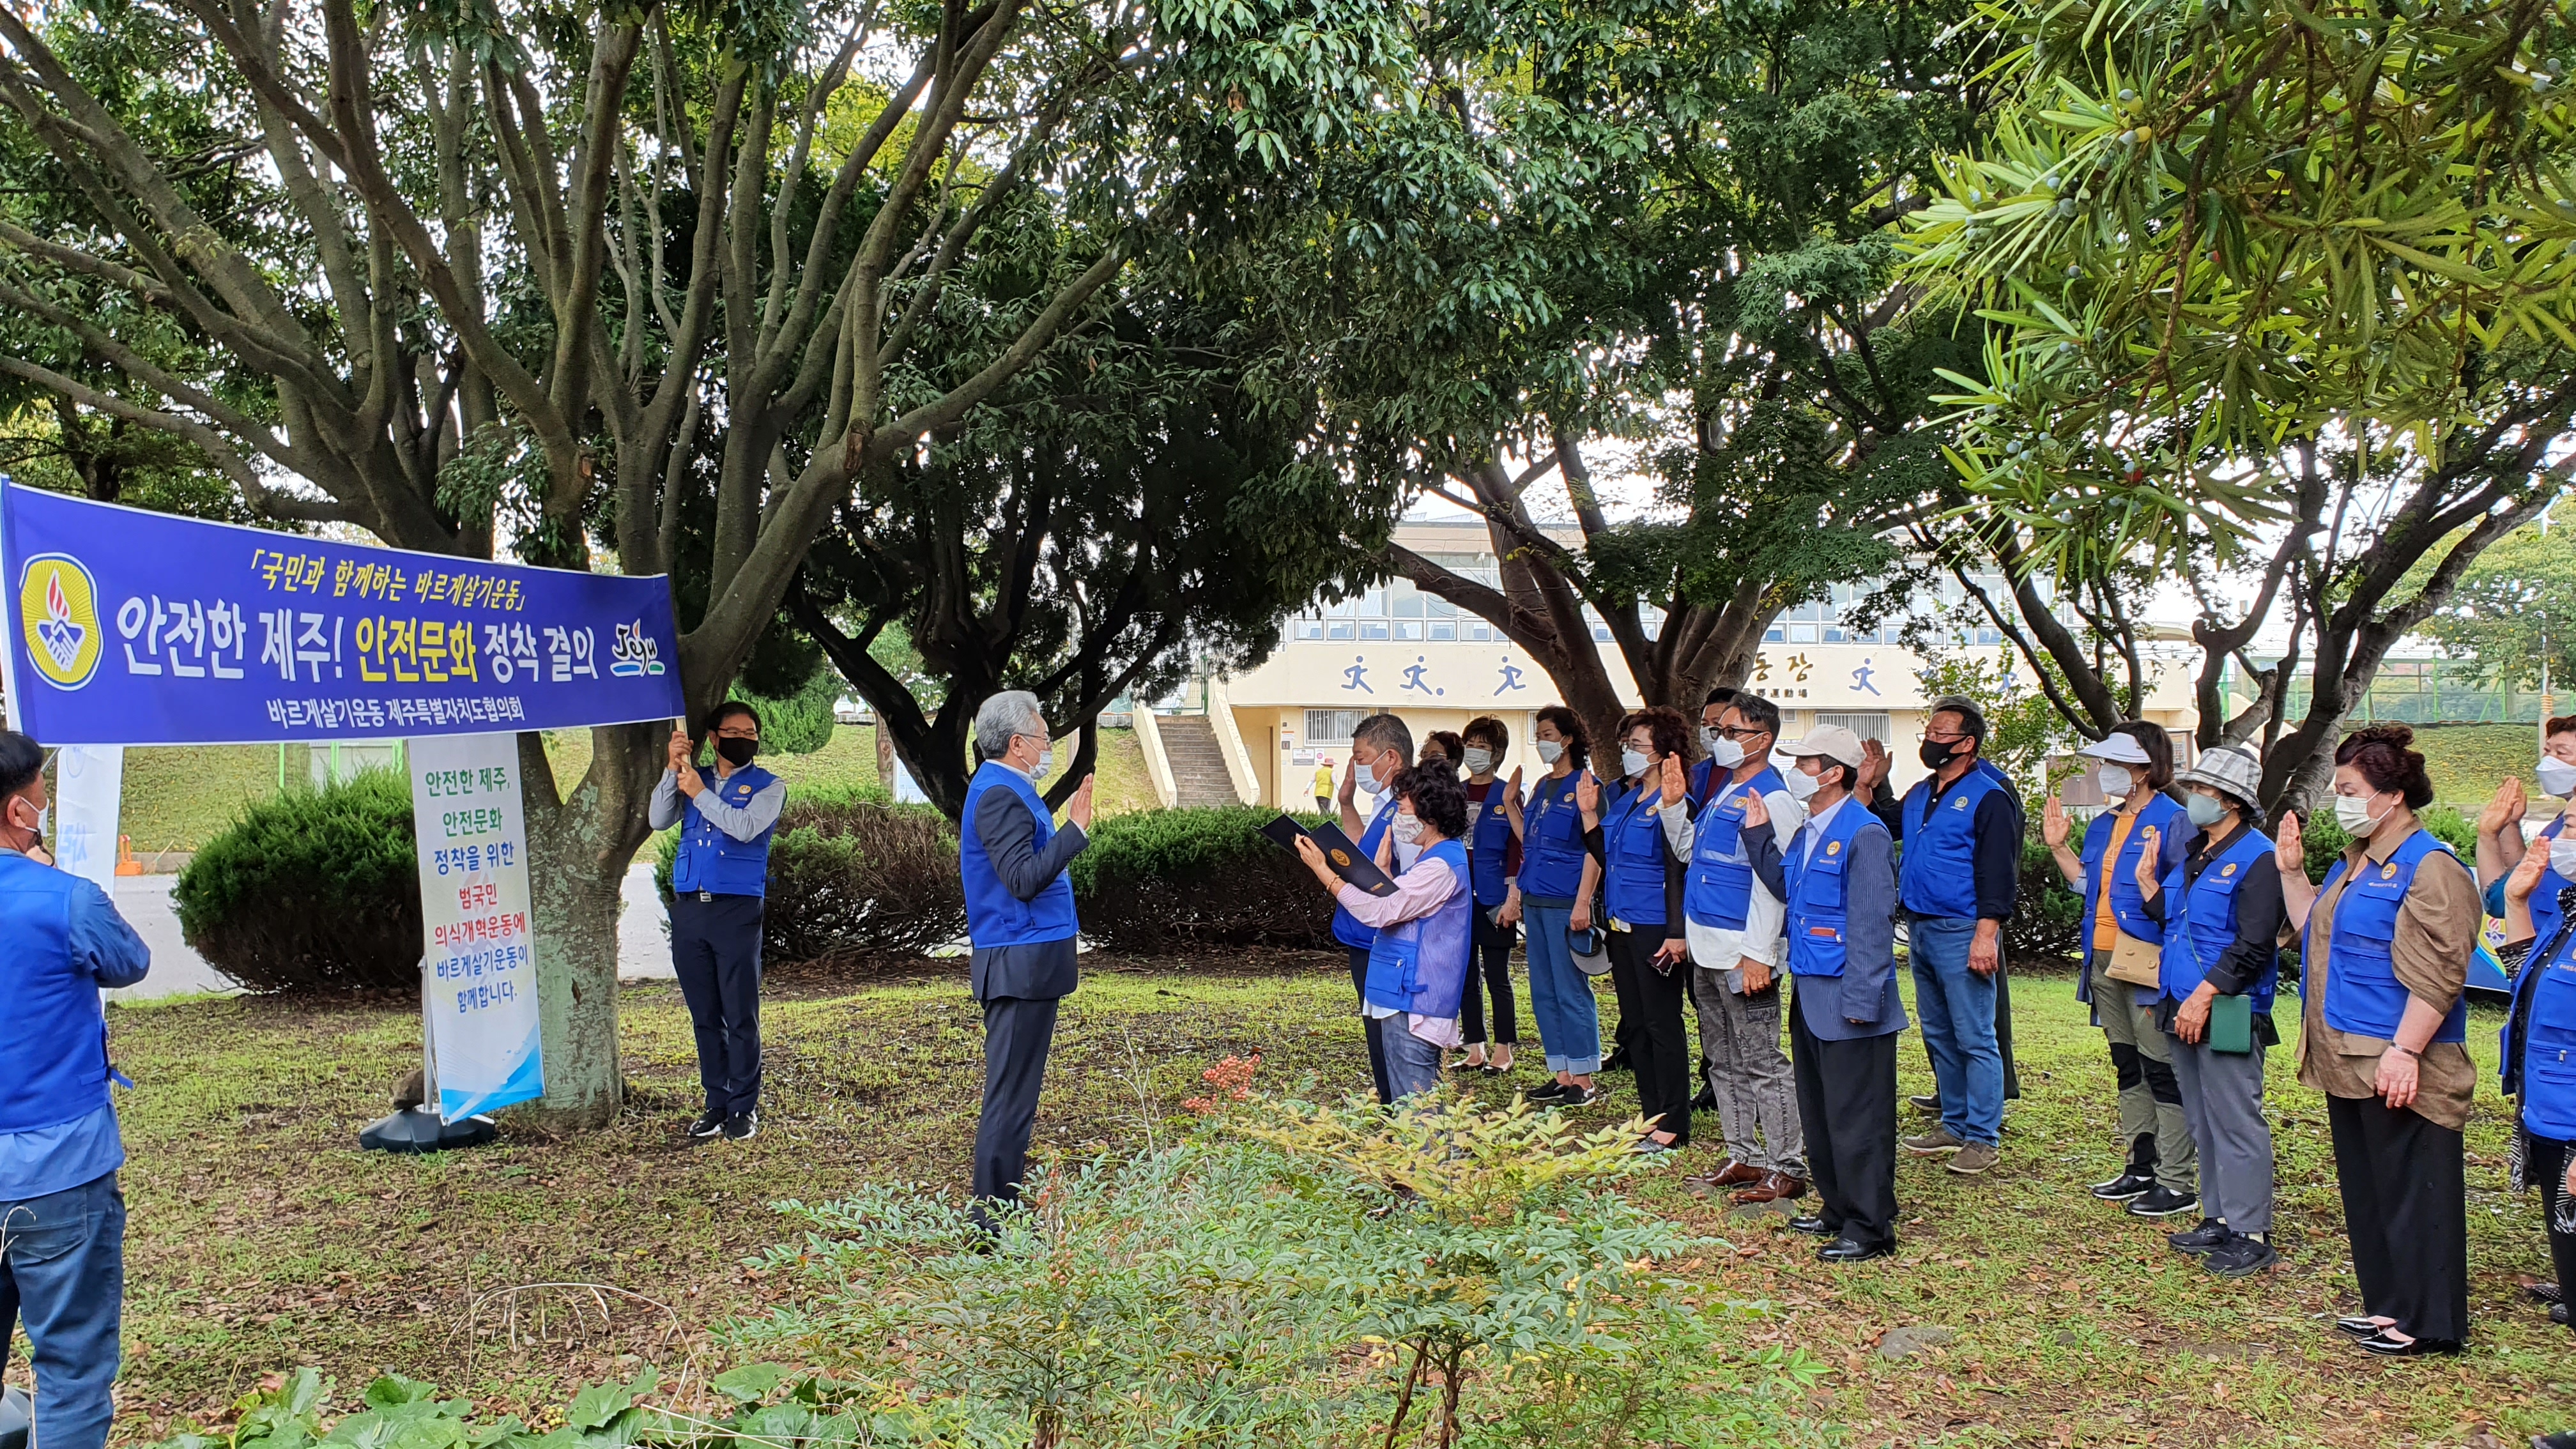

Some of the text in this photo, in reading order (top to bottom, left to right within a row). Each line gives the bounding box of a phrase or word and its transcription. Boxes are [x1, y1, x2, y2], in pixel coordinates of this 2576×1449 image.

[251, 549, 526, 611] 「국민과 함께하는 바르게살기운동」
[117, 594, 599, 684] 안전한 제주! 안전문화 정착 결의
[266, 696, 526, 730] 바르게살기운동 제주특별자치도협의회
[425, 767, 510, 797] 안전한 제주,
[443, 807, 503, 838] 안전문화
[434, 841, 514, 875] 정착을 위한
[459, 882, 498, 910] 범국민
[435, 911, 526, 947] 의식개혁운동에
[437, 944, 529, 983] 바르게살기운동이
[457, 979, 518, 1014] 함께합니다.
